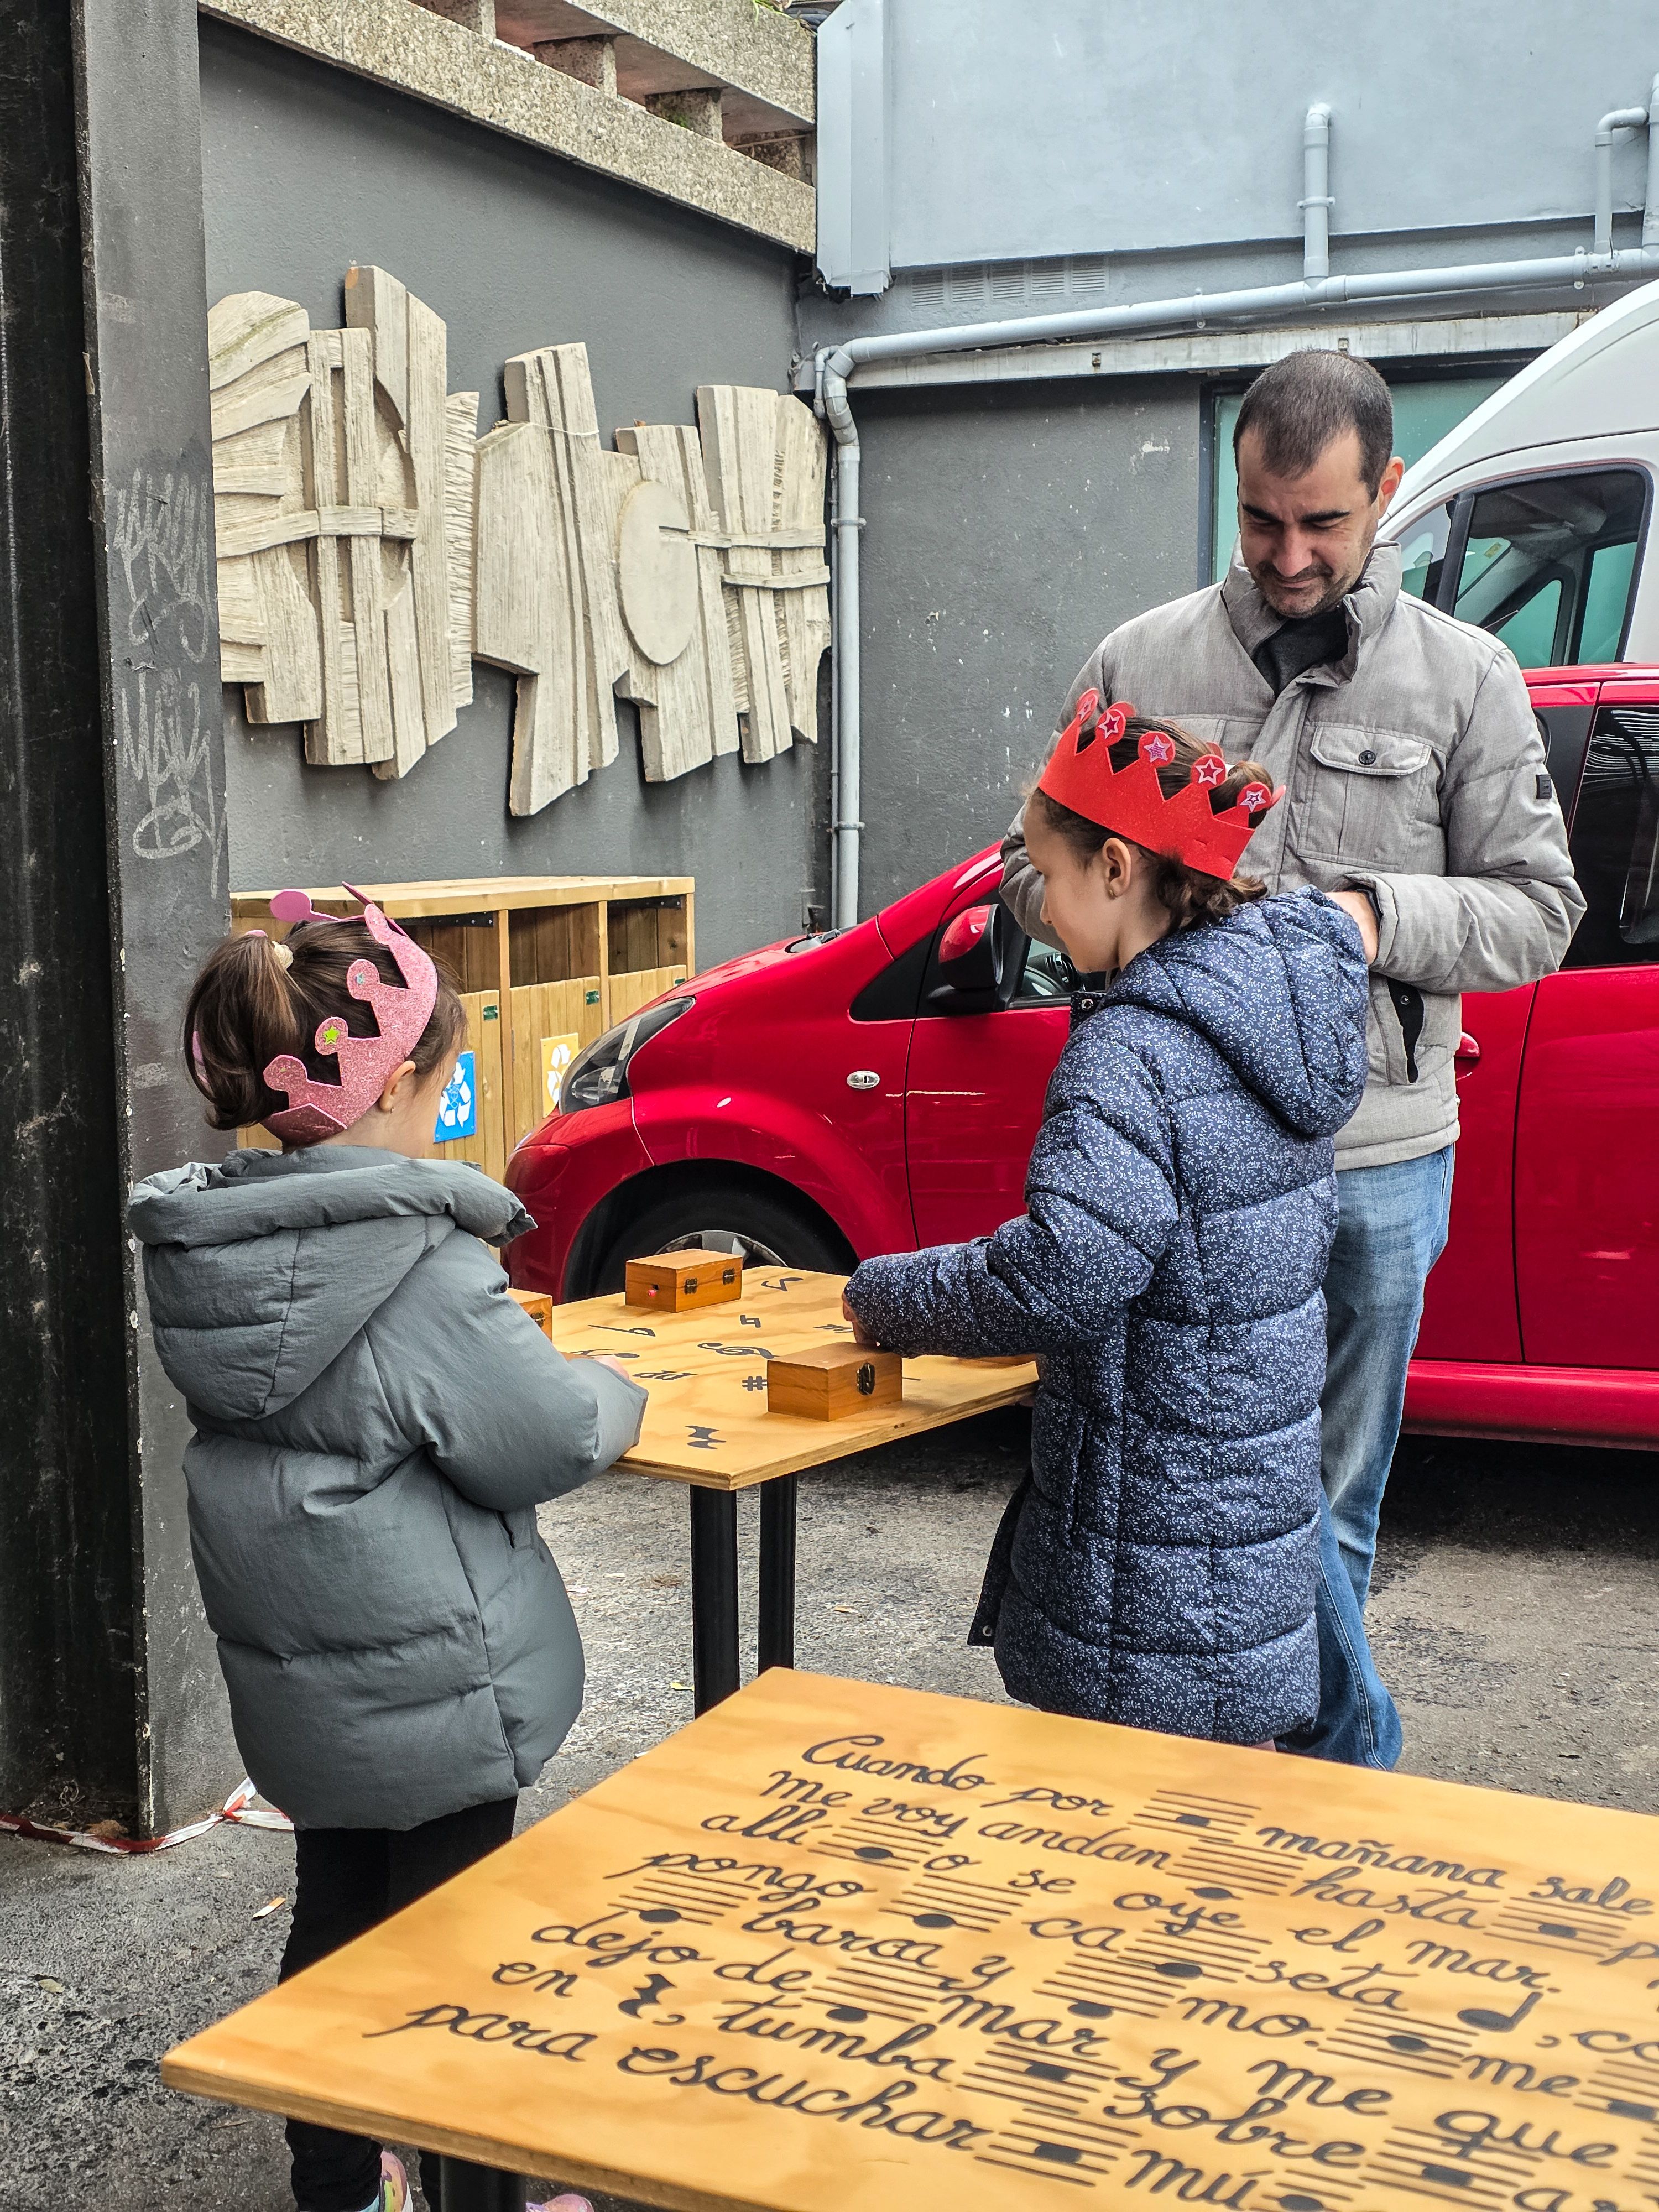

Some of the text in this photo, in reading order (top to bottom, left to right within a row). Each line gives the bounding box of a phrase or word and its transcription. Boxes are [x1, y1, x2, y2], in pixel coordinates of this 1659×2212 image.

[701, 1804, 1562, 1993] allí o se oye el mar.
[801, 1735, 1655, 1914] Cuando por mañana sale
[862, 1798, 969, 1839] voy
[978, 1822, 1172, 1870] andan
[1290, 1866, 1500, 1929] hasta
[603, 1851, 878, 1902] pongo
[1022, 1918, 1126, 1953] ca
[1245, 1961, 1420, 2011] seta
[741, 1897, 945, 1968] barca
[938, 1955, 1016, 1992] y
[1460, 2054, 1580, 2098] me
[362, 2004, 598, 2062] para
[617, 2046, 994, 2150] escuchar
[492, 1961, 1367, 2169] en tumba sobre
[531, 1910, 1619, 2168] dejo de mar y me que
